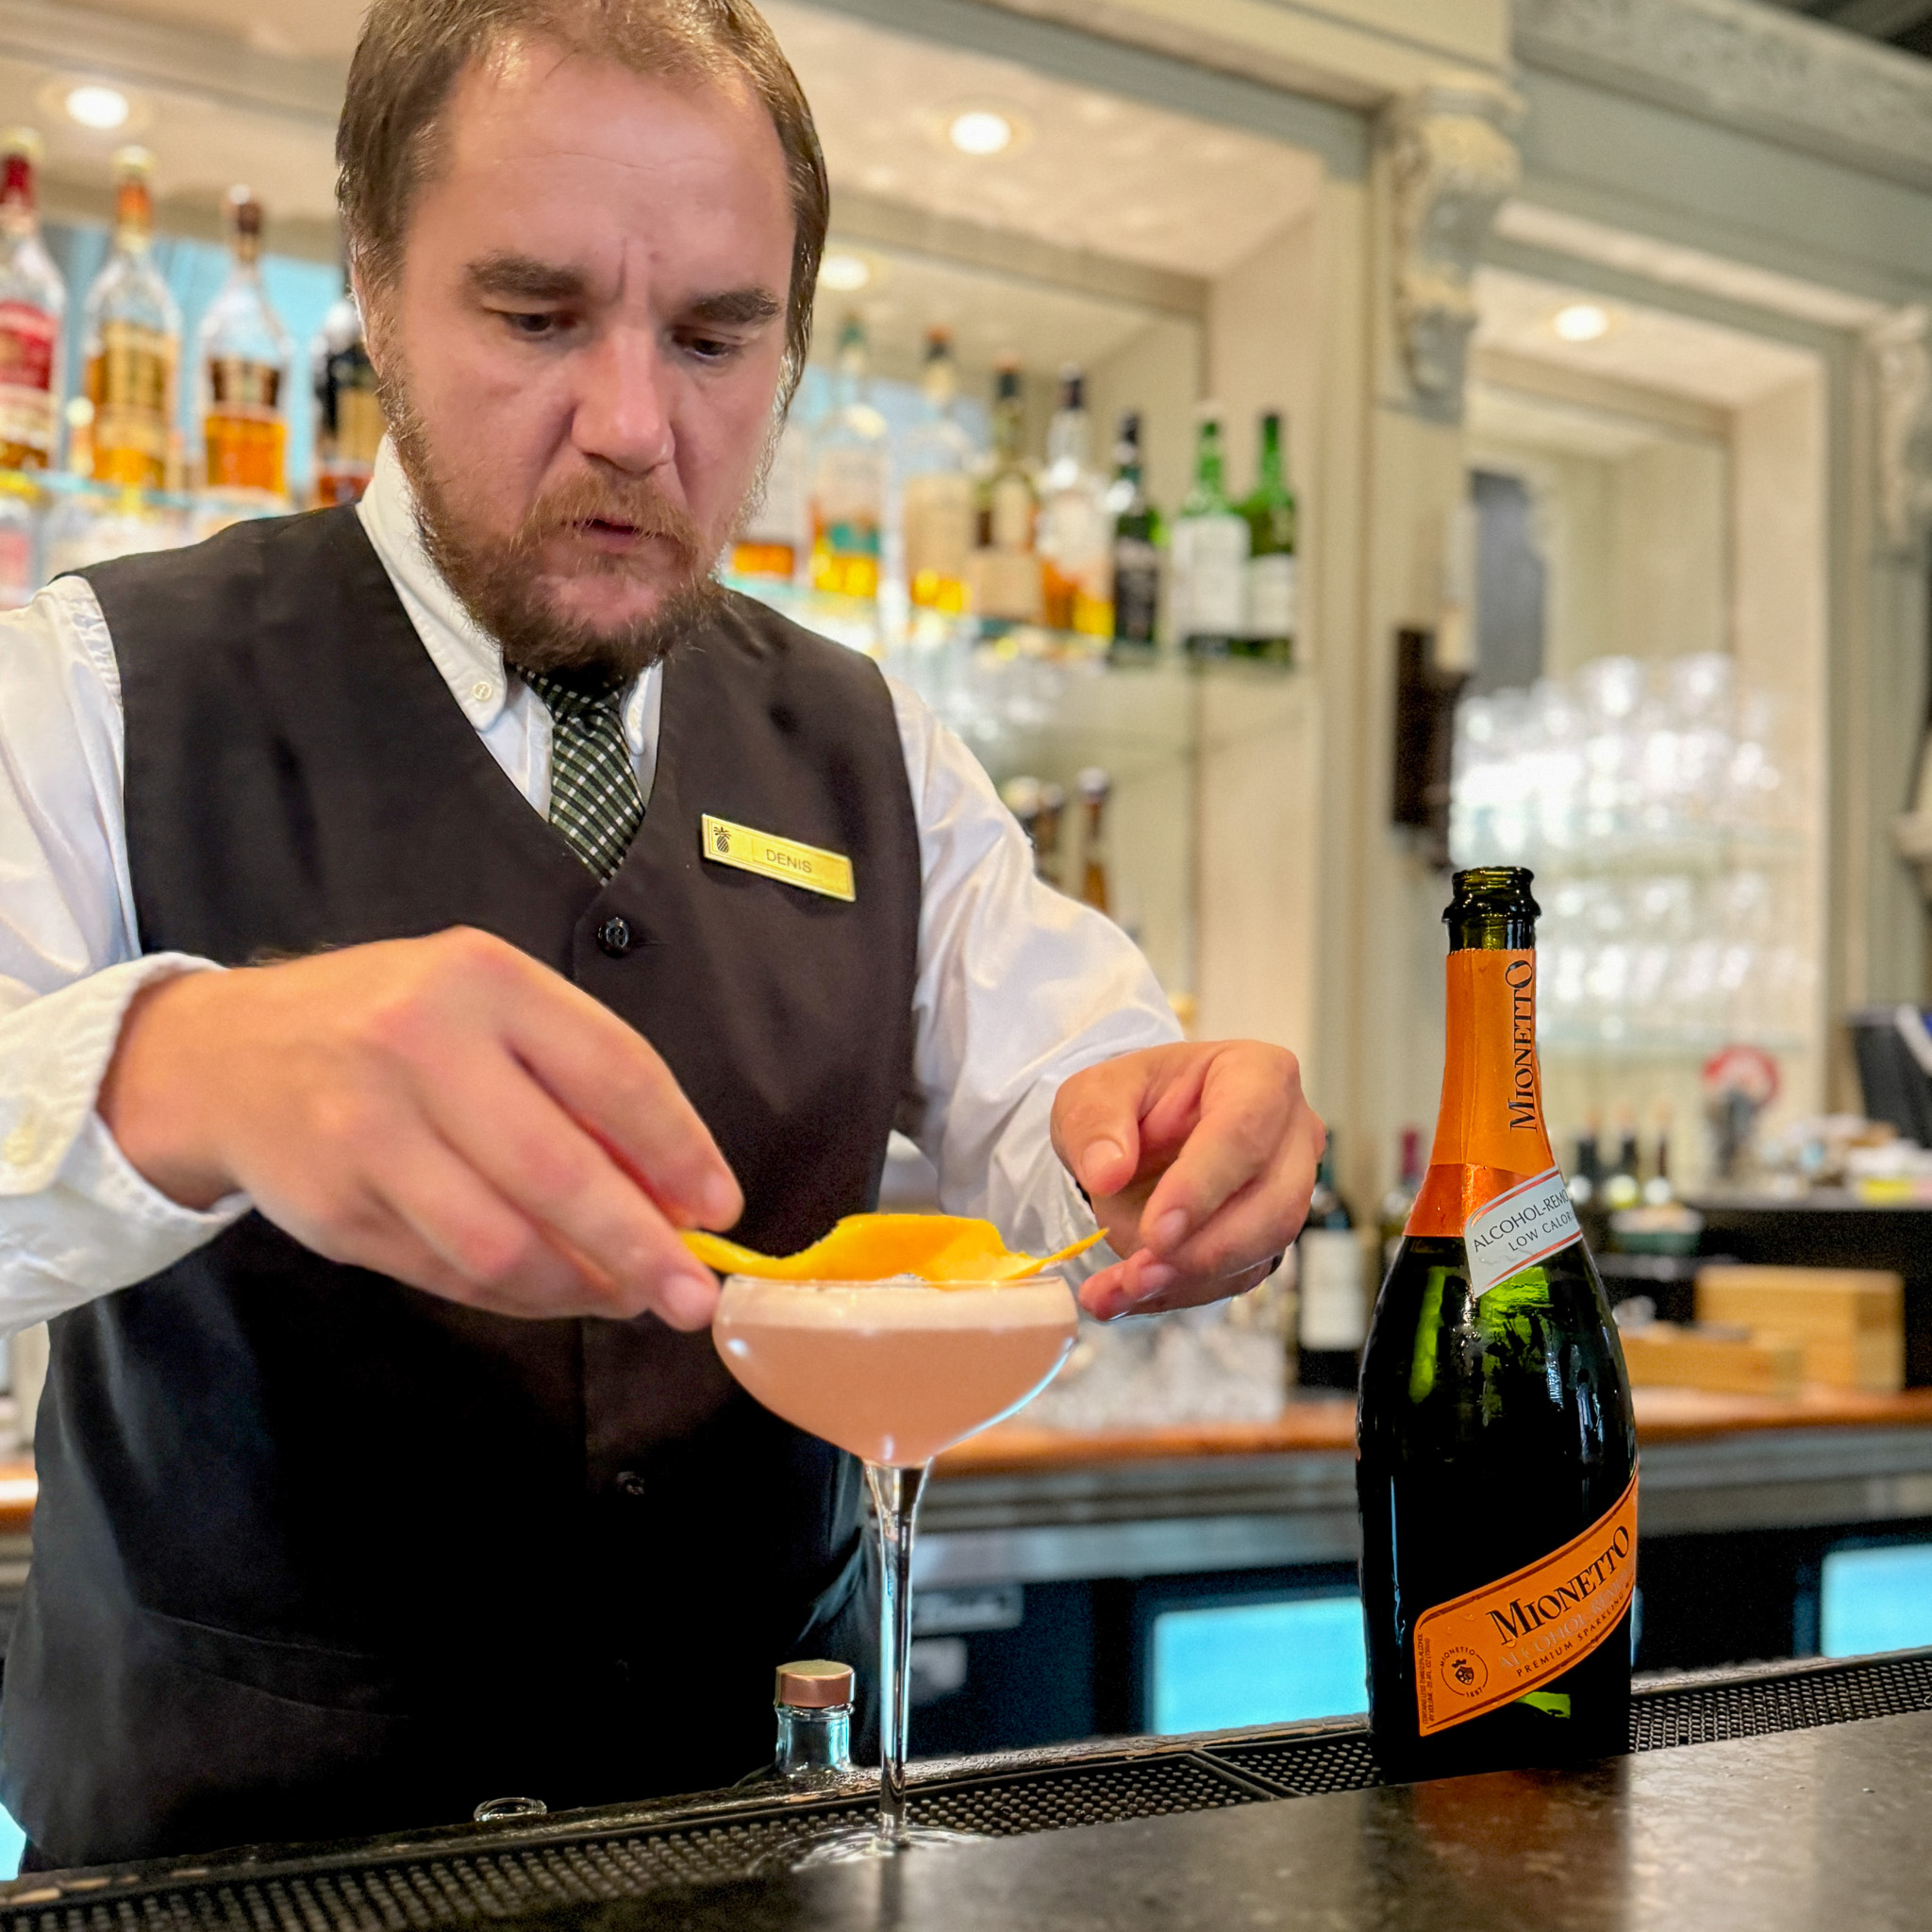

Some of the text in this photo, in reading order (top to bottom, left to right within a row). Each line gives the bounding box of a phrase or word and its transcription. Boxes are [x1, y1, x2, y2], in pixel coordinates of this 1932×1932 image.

[766, 849, 812, 874] DENIS
[1505, 959, 1537, 1132] MIONETTO
[1507, 1228, 1539, 1252] LOW
[1486, 1525, 1629, 1645] MIONETTO
[1440, 1646, 1475, 1667] MIONETTO
[1516, 1591, 1624, 1676] PREMIUM SPARKLING
